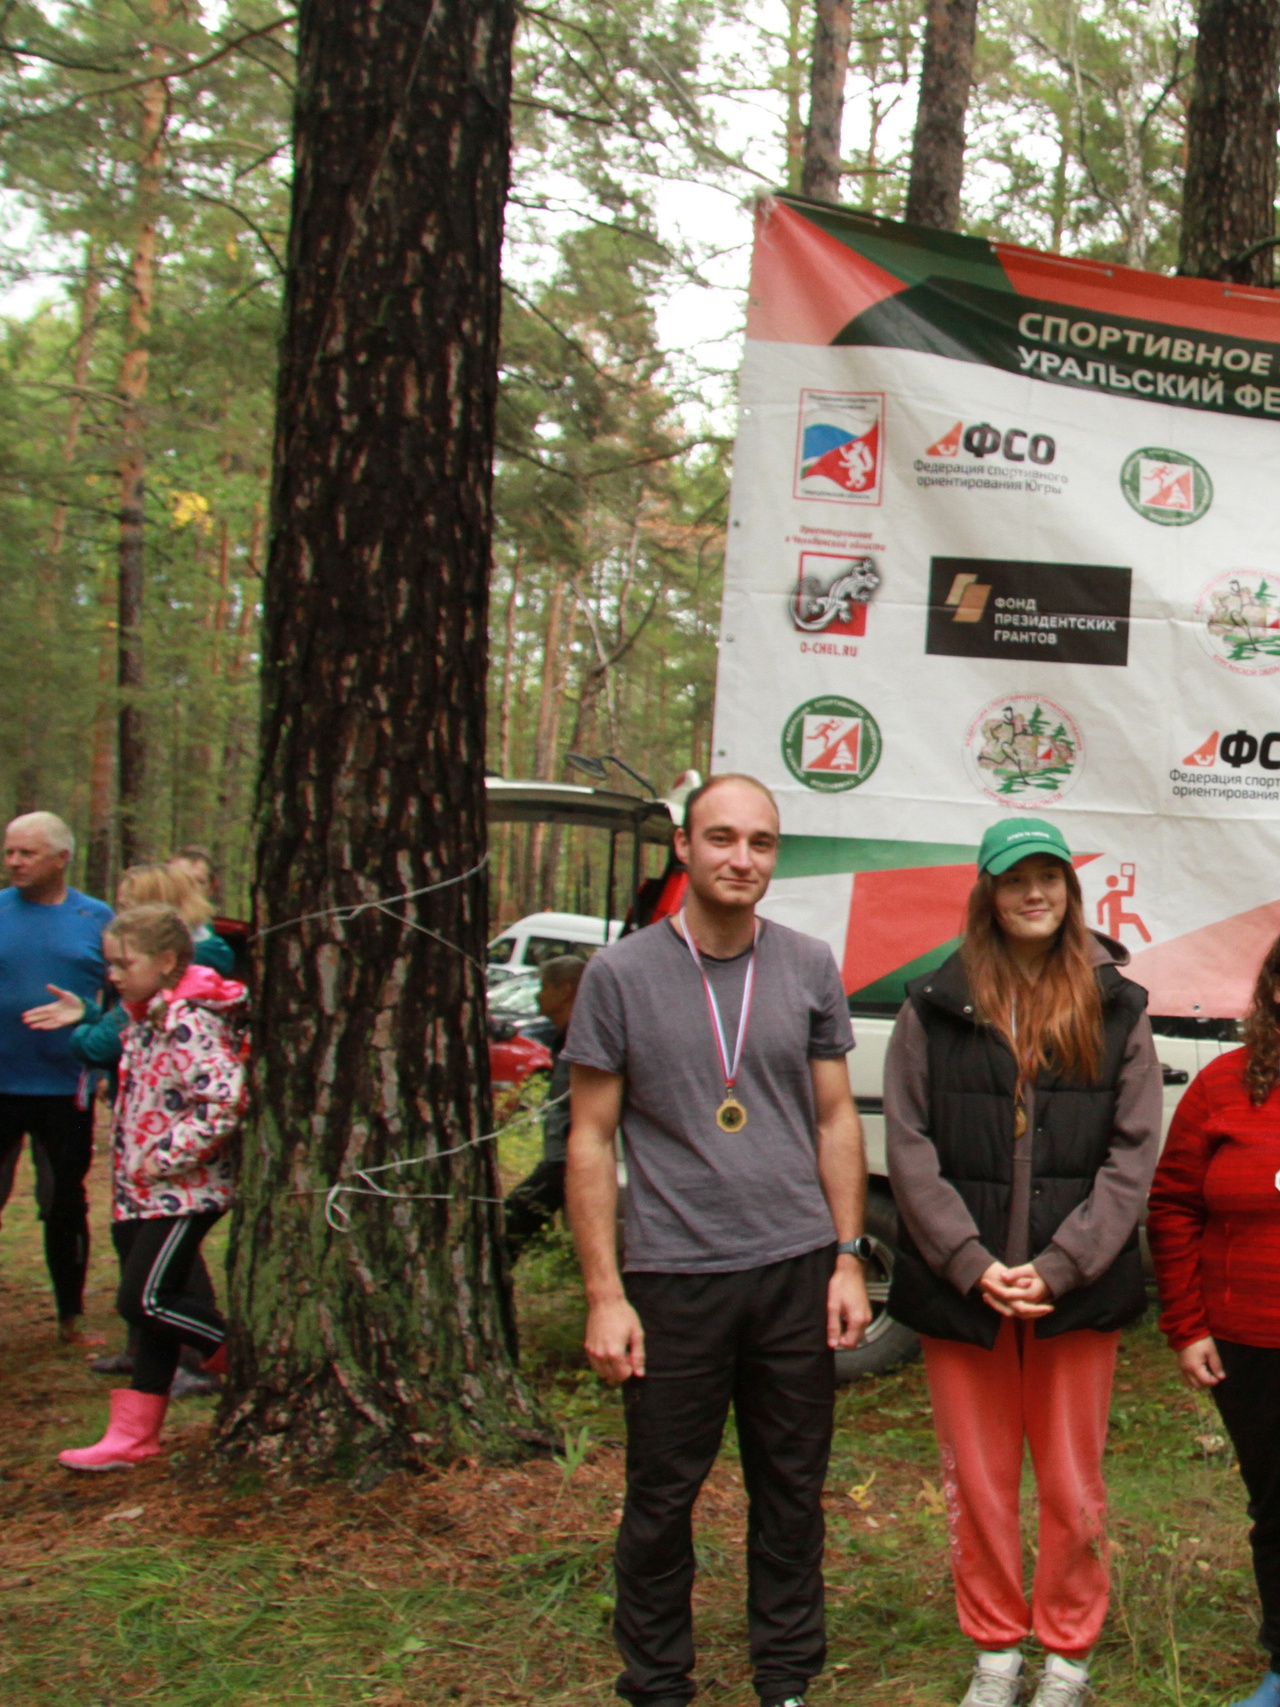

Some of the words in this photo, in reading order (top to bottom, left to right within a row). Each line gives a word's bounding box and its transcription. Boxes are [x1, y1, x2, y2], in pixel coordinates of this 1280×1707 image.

[1018, 312, 1273, 376] СПОРТИВНОЕ
[1017, 345, 1224, 405] УРАЛЬСКИЙ
[962, 421, 1056, 465] ФСО
[913, 459, 985, 475] Федерация
[987, 465, 1069, 484] спортивного
[916, 476, 1022, 491] ориентирования
[1024, 478, 1062, 495] Югры
[994, 597, 1037, 611] ФОНД
[994, 613, 1117, 631] ПРЕЗИДЕНТСКИХ
[994, 630, 1058, 645] ГРАНТОВ
[1169, 769, 1241, 785] Федерация
[1172, 785, 1279, 801] ориентирования
